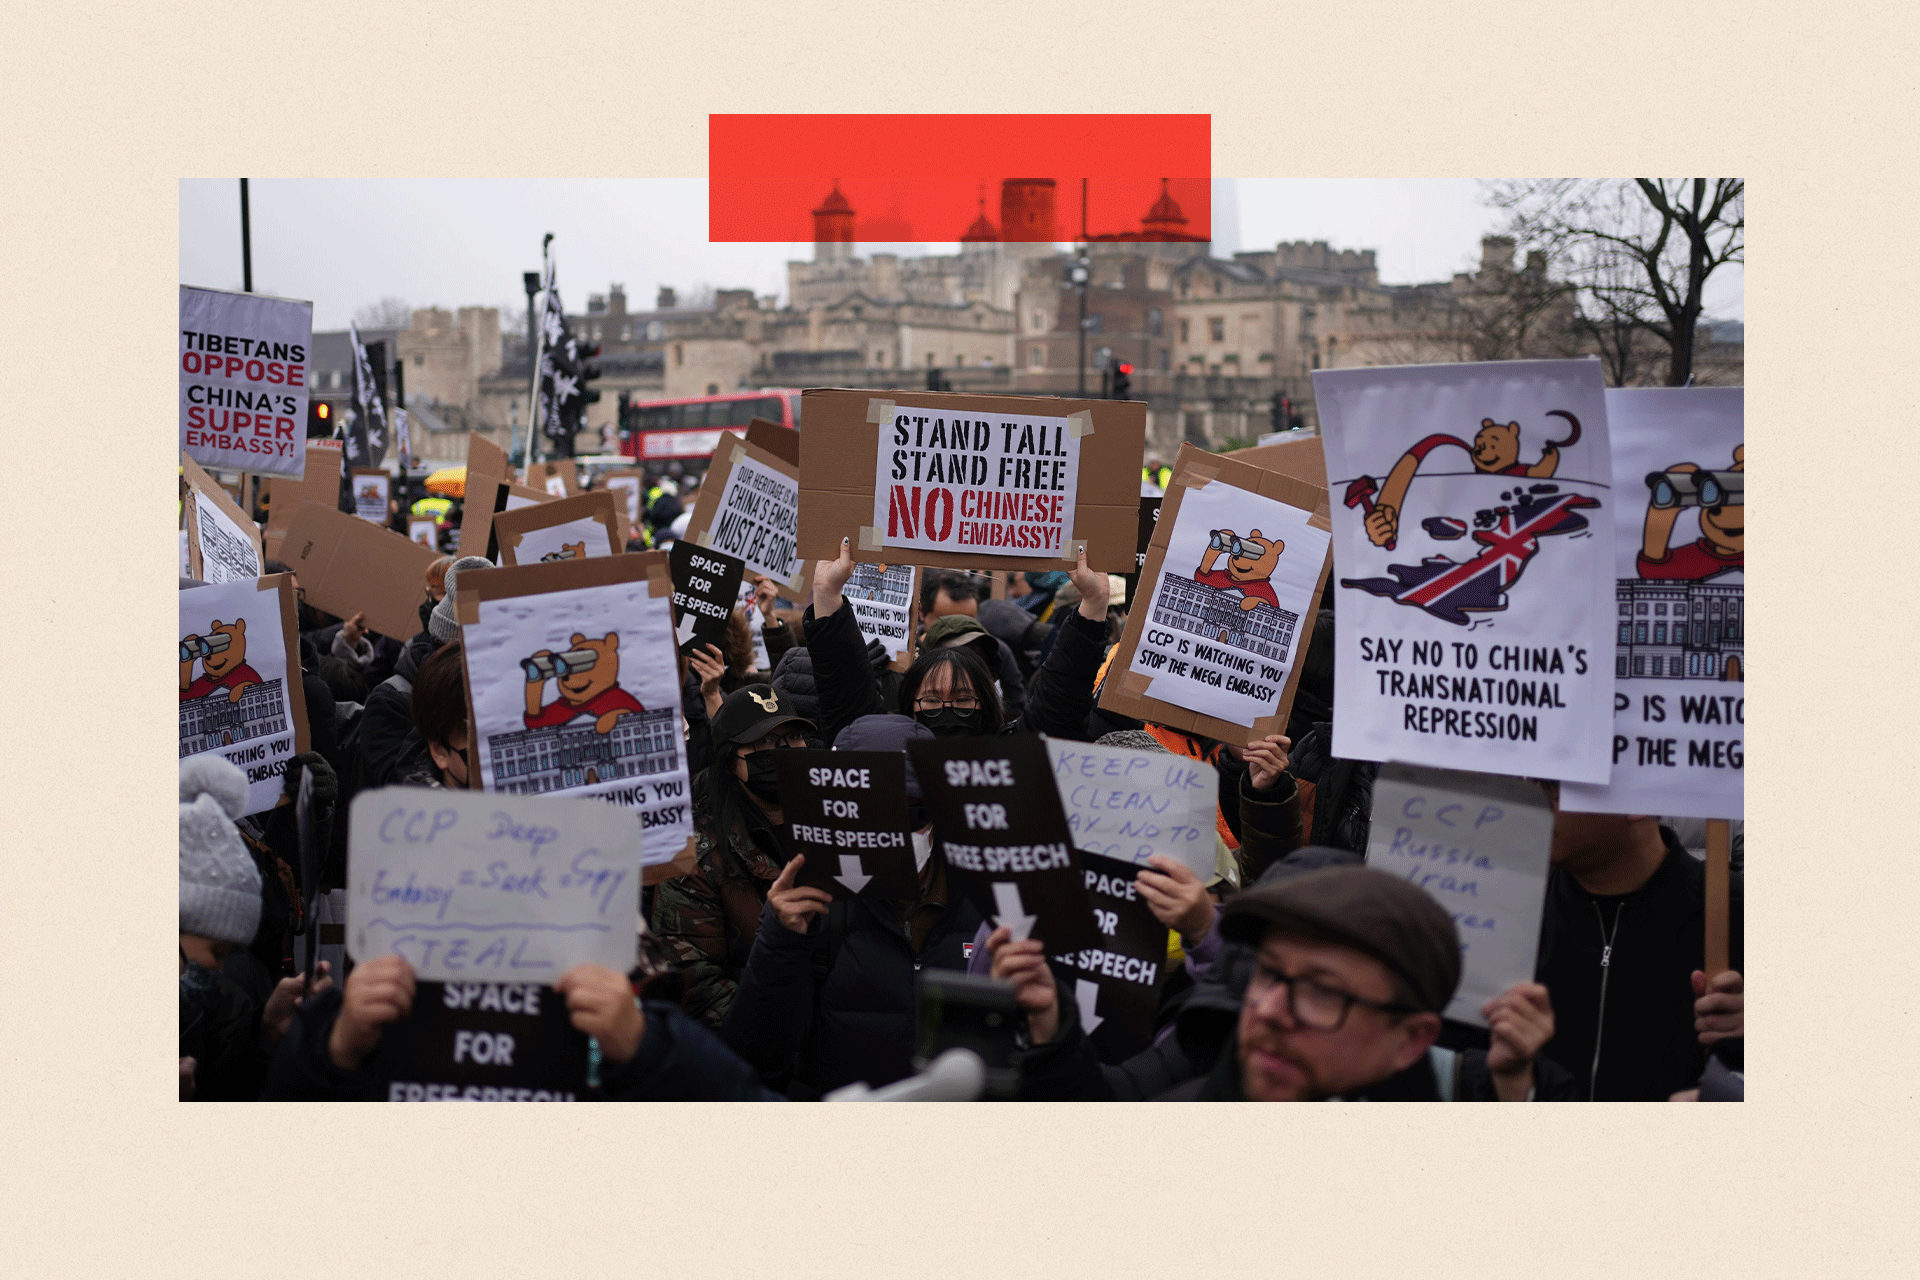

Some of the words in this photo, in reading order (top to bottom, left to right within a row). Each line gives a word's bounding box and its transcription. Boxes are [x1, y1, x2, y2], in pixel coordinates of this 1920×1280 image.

[182, 330, 305, 363] TIBETANS
[182, 351, 304, 387] OPPOSE
[187, 385, 297, 415] CHINA'S
[187, 406, 295, 441] SUPER
[893, 414, 990, 452] STAND
[1001, 422, 1067, 457] TALL
[186, 430, 294, 458] EMBASSY!
[737, 465, 754, 487] OUR
[752, 473, 785, 501] HERITAGE
[782, 488, 791, 504] IS
[891, 449, 987, 486] STAND
[998, 457, 1067, 491] FREE
[728, 484, 770, 521] CHINA'S
[887, 484, 954, 542] NO
[960, 489, 1064, 523] CHINESE
[712, 509, 755, 557] MUST
[746, 525, 771, 564] BE
[763, 532, 797, 579] GONE!
[958, 521, 1062, 550] EMBASSY!
[689, 554, 726, 577] SPACE
[688, 575, 712, 594] FOR
[686, 596, 729, 620] SPEECH
[856, 603, 890, 621] WATCHING
[892, 610, 906, 623] YOU
[877, 623, 906, 640] EMBASSY
[1147, 629, 1174, 647] CCP
[1177, 638, 1190, 655] IS
[1194, 642, 1255, 675] WATCHING
[1260, 664, 1284, 683] YOU
[1360, 636, 1403, 663] SAY
[1413, 640, 1443, 668] NO
[1451, 642, 1478, 670] TO
[1489, 644, 1588, 676] CHINA'S
[1139, 649, 1168, 670] STOP
[1168, 658, 1187, 677] THE
[1190, 665, 1222, 688] MEGA
[1225, 675, 1277, 703] EMBASSY
[1376, 669, 1566, 709] TRANSNATIONAL
[1404, 703, 1538, 742] REPRESSION
[1643, 694, 1666, 723] IS
[270, 738, 290, 756] YOU
[1636, 736, 1677, 767] THE
[808, 767, 871, 789] SPACE
[944, 758, 1015, 787] SPACE
[1056, 750, 1150, 778] KEEP
[1164, 764, 1205, 791] UK
[653, 780, 683, 801] YOU
[1070, 784, 1171, 814] CLEAN
[822, 799, 859, 819] FOR
[964, 803, 1009, 830] FOR
[1402, 795, 1505, 831] CCP
[379, 807, 459, 845] CCP
[792, 823, 833, 845] FREE
[834, 829, 905, 848] SPEECH
[1118, 820, 1161, 838] NO
[1170, 824, 1201, 842] TO
[943, 841, 985, 872] FREE
[983, 842, 1071, 872] SPEECH
[1389, 826, 1495, 871] Russia
[1077, 948, 1157, 986] SPEECH
[442, 981, 542, 1017] SPACE
[453, 1029, 516, 1067] FOR
